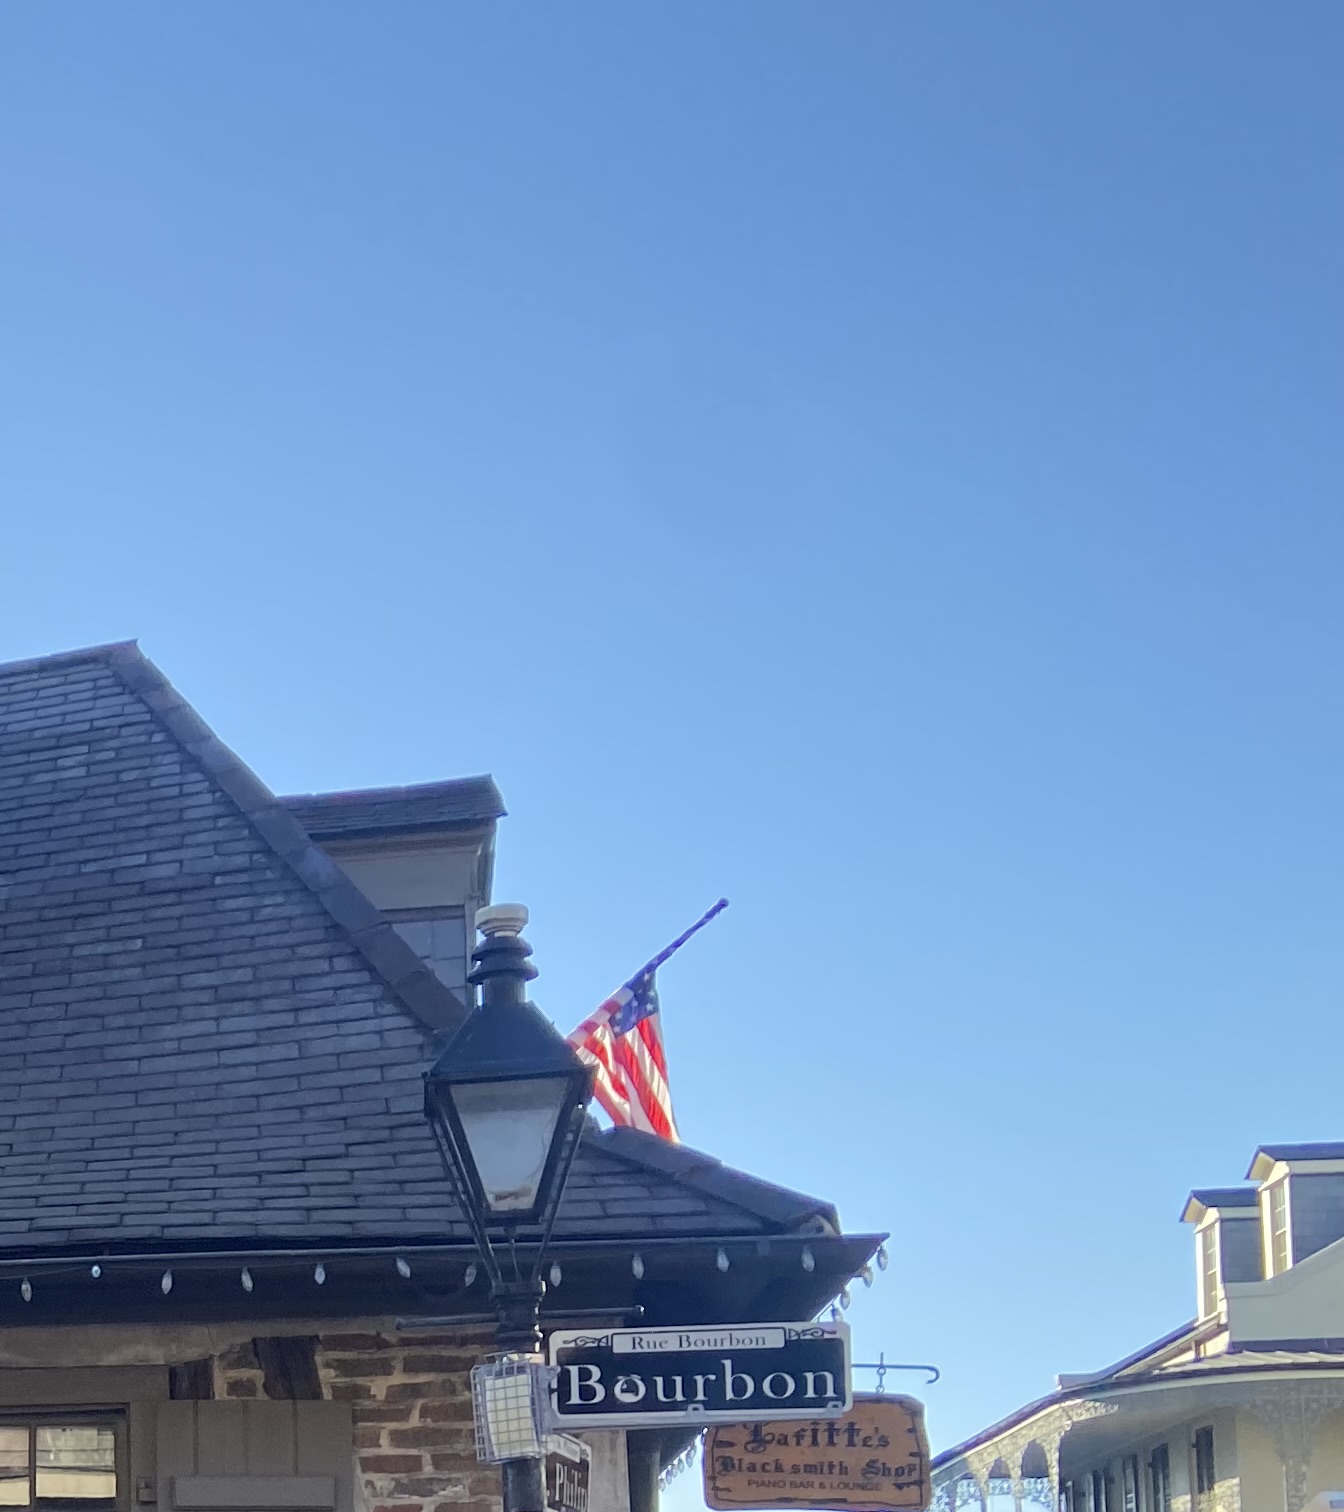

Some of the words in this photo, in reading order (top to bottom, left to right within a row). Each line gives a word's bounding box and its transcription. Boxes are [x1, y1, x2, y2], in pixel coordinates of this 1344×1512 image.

[631, 1335, 668, 1350] Rue
[678, 1332, 766, 1348] Bourbon
[565, 1359, 839, 1405] Bourbon
[743, 1421, 890, 1453] Lafitte's
[747, 1479, 786, 1489] PIANO
[790, 1480, 814, 1490] BAR
[819, 1480, 827, 1490] &
[830, 1481, 883, 1491] LOUNGE
